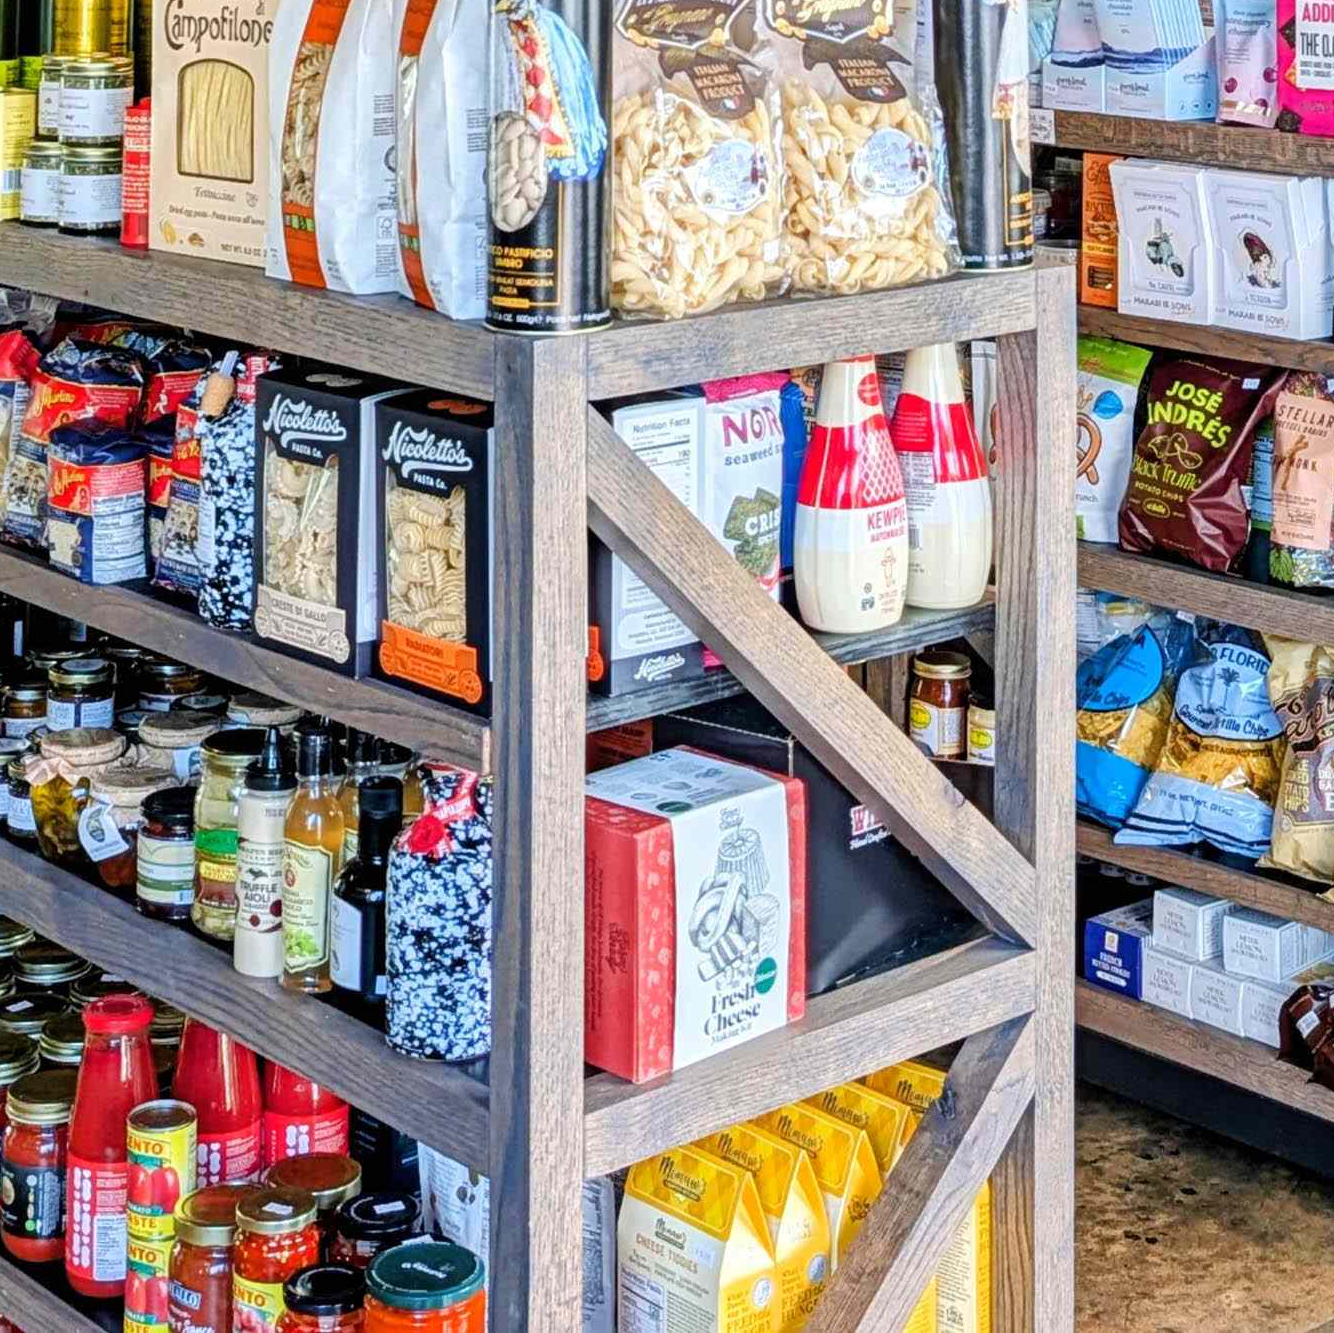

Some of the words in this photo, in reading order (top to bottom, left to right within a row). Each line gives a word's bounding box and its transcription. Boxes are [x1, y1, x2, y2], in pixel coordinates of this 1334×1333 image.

[1300, 32, 1321, 60] THE
[1166, 379, 1224, 415] JOSÉ
[261, 392, 347, 441] Nicoletto's
[633, 422, 667, 434] Nutrition
[669, 416, 691, 428] Facts
[291, 442, 312, 457] PASTA
[381, 420, 473, 472] Nicoletto's
[724, 447, 774, 467] seaweed
[413, 472, 435, 487] PASTA
[240, 879, 278, 894] TRUFFLE
[244, 891, 270, 904] AIOLI
[710, 982, 757, 1015] Fresh
[703, 1001, 761, 1037] Cheese
